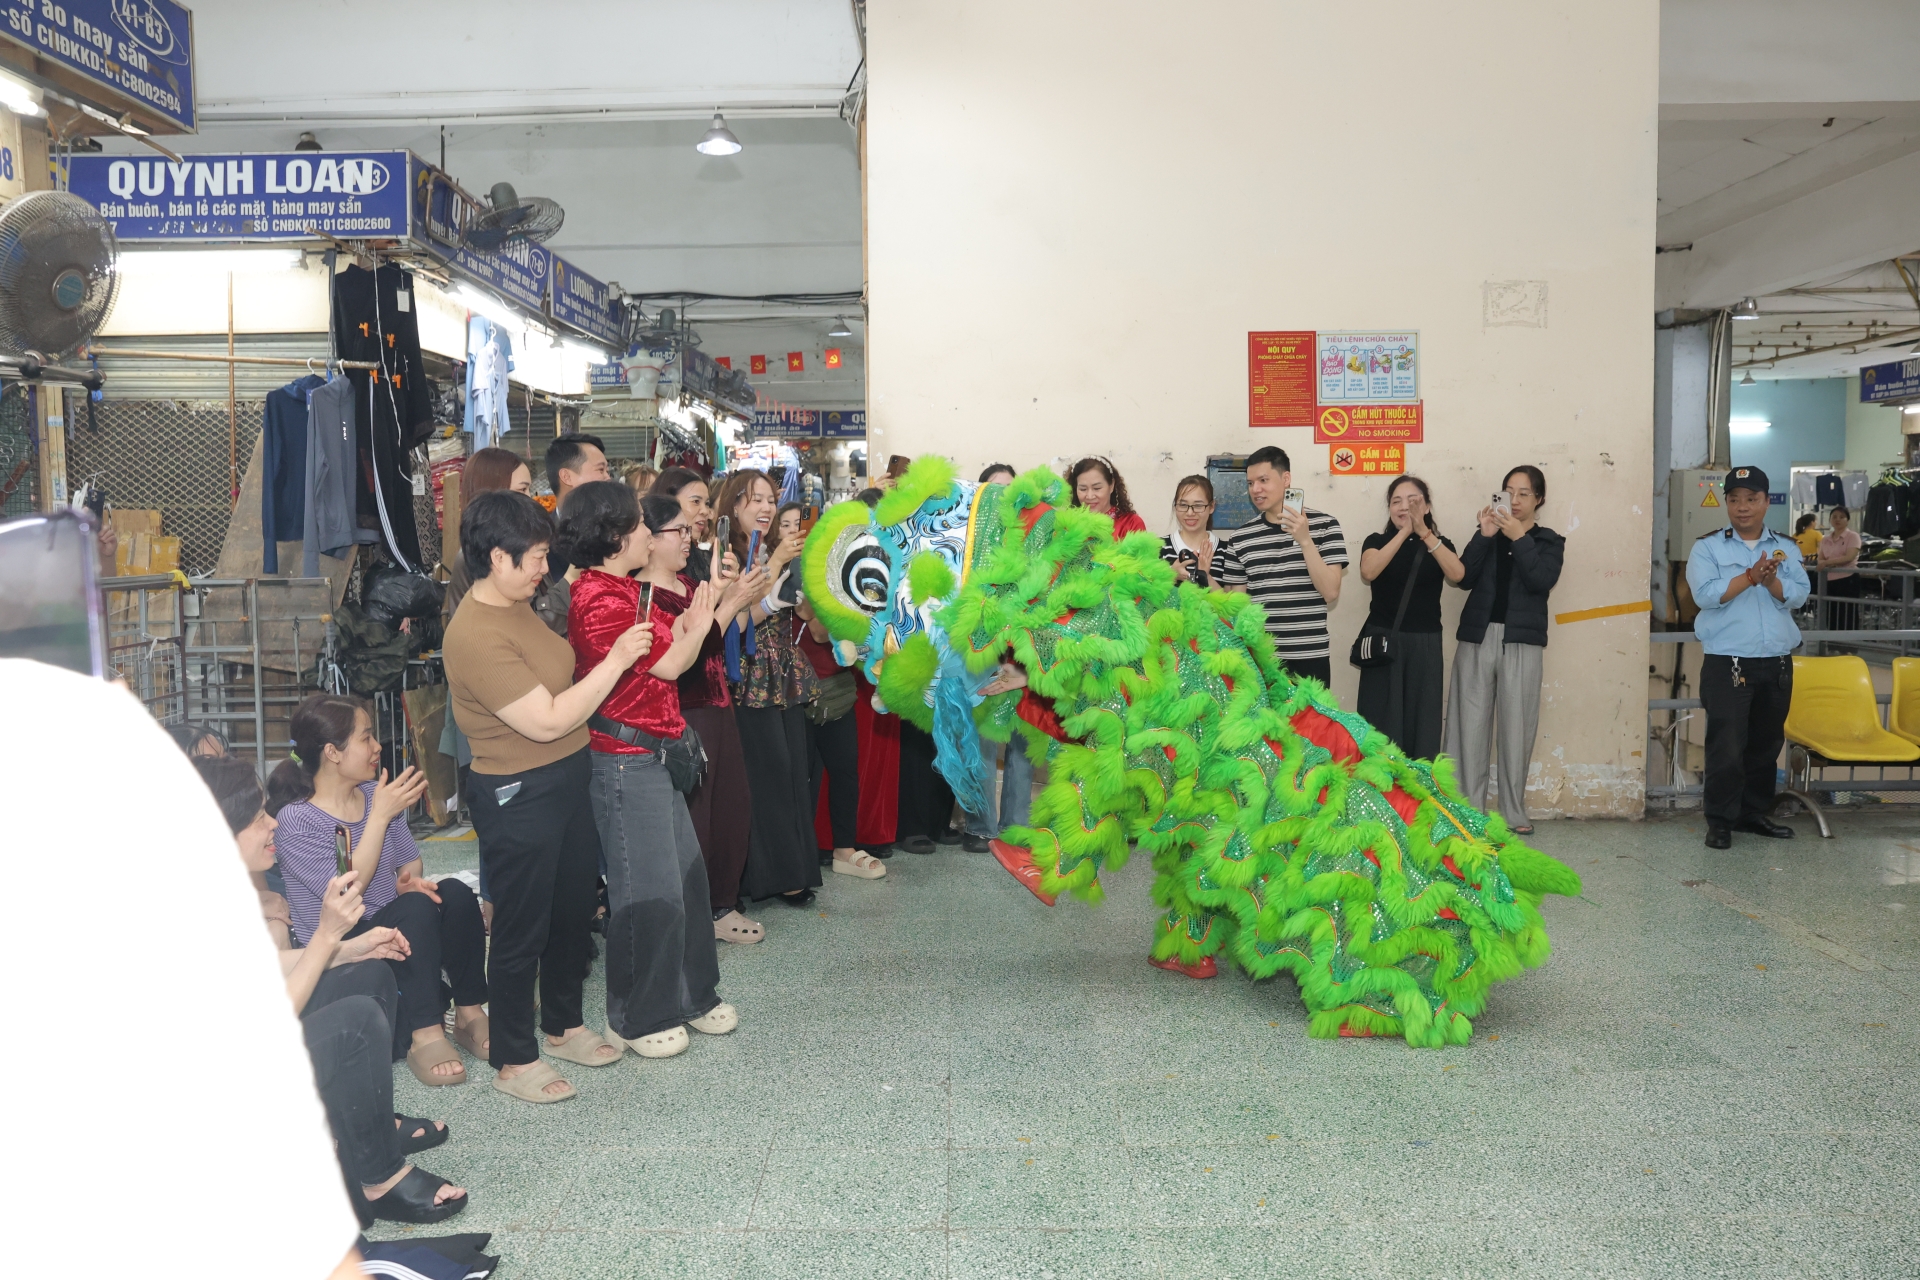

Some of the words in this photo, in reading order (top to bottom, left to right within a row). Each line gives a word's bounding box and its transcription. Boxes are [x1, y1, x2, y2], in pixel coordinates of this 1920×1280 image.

[122, 0, 163, 44] 41-B3
[73, 15, 113, 55] may
[265, 158, 373, 194] LOAN
[100, 202, 125, 218] Bán
[128, 202, 164, 218] buôn,
[169, 201, 193, 217] bán
[196, 198, 209, 216] lẻ
[212, 200, 236, 216] các
[241, 200, 265, 218] mặt
[272, 199, 304, 216] hàng
[308, 201, 335, 216] may
[1344, 336, 1364, 344] LỆNH
[1267, 345, 1280, 354] NỘI
[1281, 346, 1296, 354] QUY
[1352, 405, 1367, 419] CẤM
[1369, 407, 1383, 419] HÚT
[1384, 405, 1406, 419] THUỐC
[1408, 407, 1416, 418] LÁ
[1373, 429, 1410, 437] SMOKING
[1360, 447, 1380, 459] CẤM
[1384, 446, 1401, 459] LỬA
[1363, 461, 1376, 472] NO
[1380, 461, 1399, 472] FIRE
